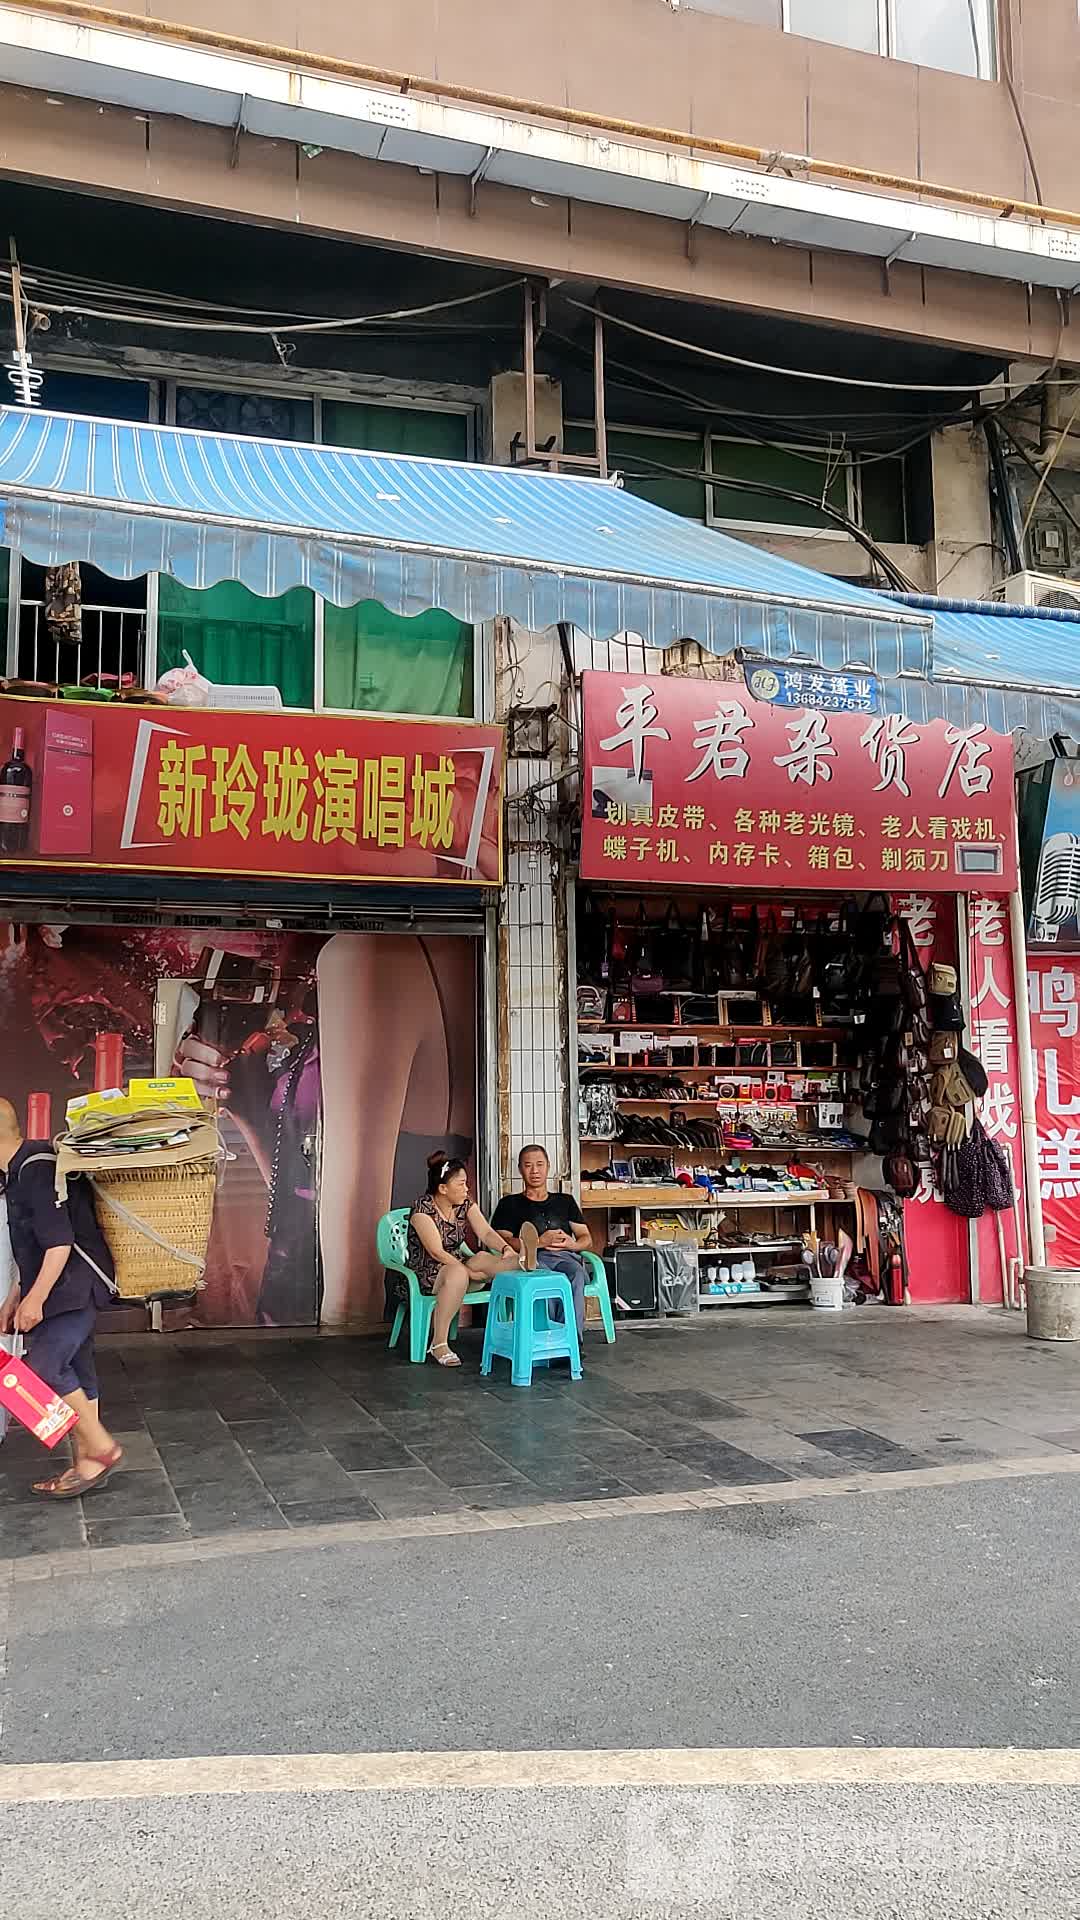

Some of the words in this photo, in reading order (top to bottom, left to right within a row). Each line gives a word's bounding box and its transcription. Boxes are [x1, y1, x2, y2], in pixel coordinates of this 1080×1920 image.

[600, 685, 993, 798] 平君杂货店
[786, 691, 871, 710] 13684237512
[157, 739, 457, 850] 新玲珑演唱城
[968, 897, 1021, 1202] 老人看戏
